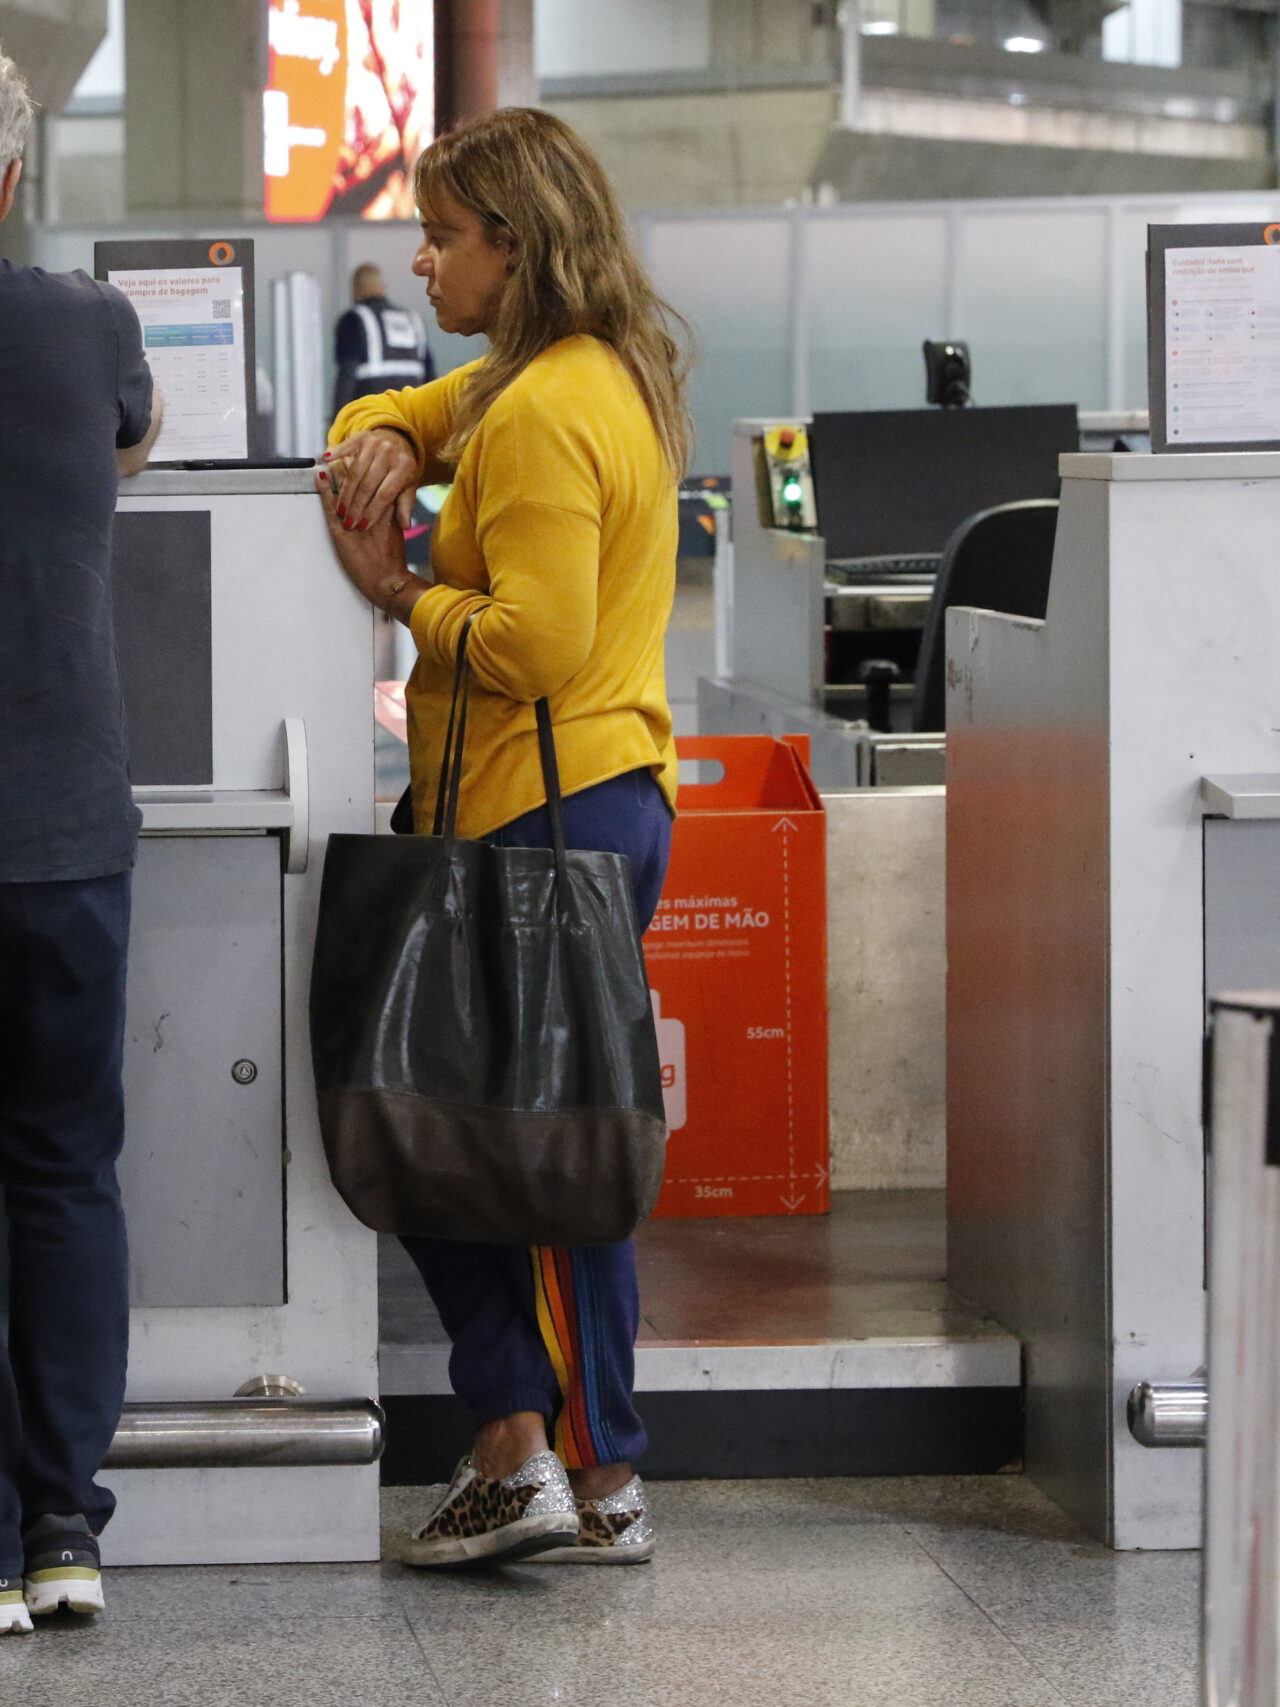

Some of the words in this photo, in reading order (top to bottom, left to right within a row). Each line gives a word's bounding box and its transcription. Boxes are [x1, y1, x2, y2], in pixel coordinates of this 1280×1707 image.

[137, 279, 156, 288] aqui
[169, 277, 199, 285] valores
[201, 276, 220, 285] para
[158, 288, 168, 296] de
[170, 287, 208, 296] bagagem
[674, 895, 738, 909] máximas
[695, 913, 720, 930] DE
[724, 907, 770, 929] MÃO
[747, 1026, 784, 1039] 55cm
[694, 1185, 733, 1198] 35cm
